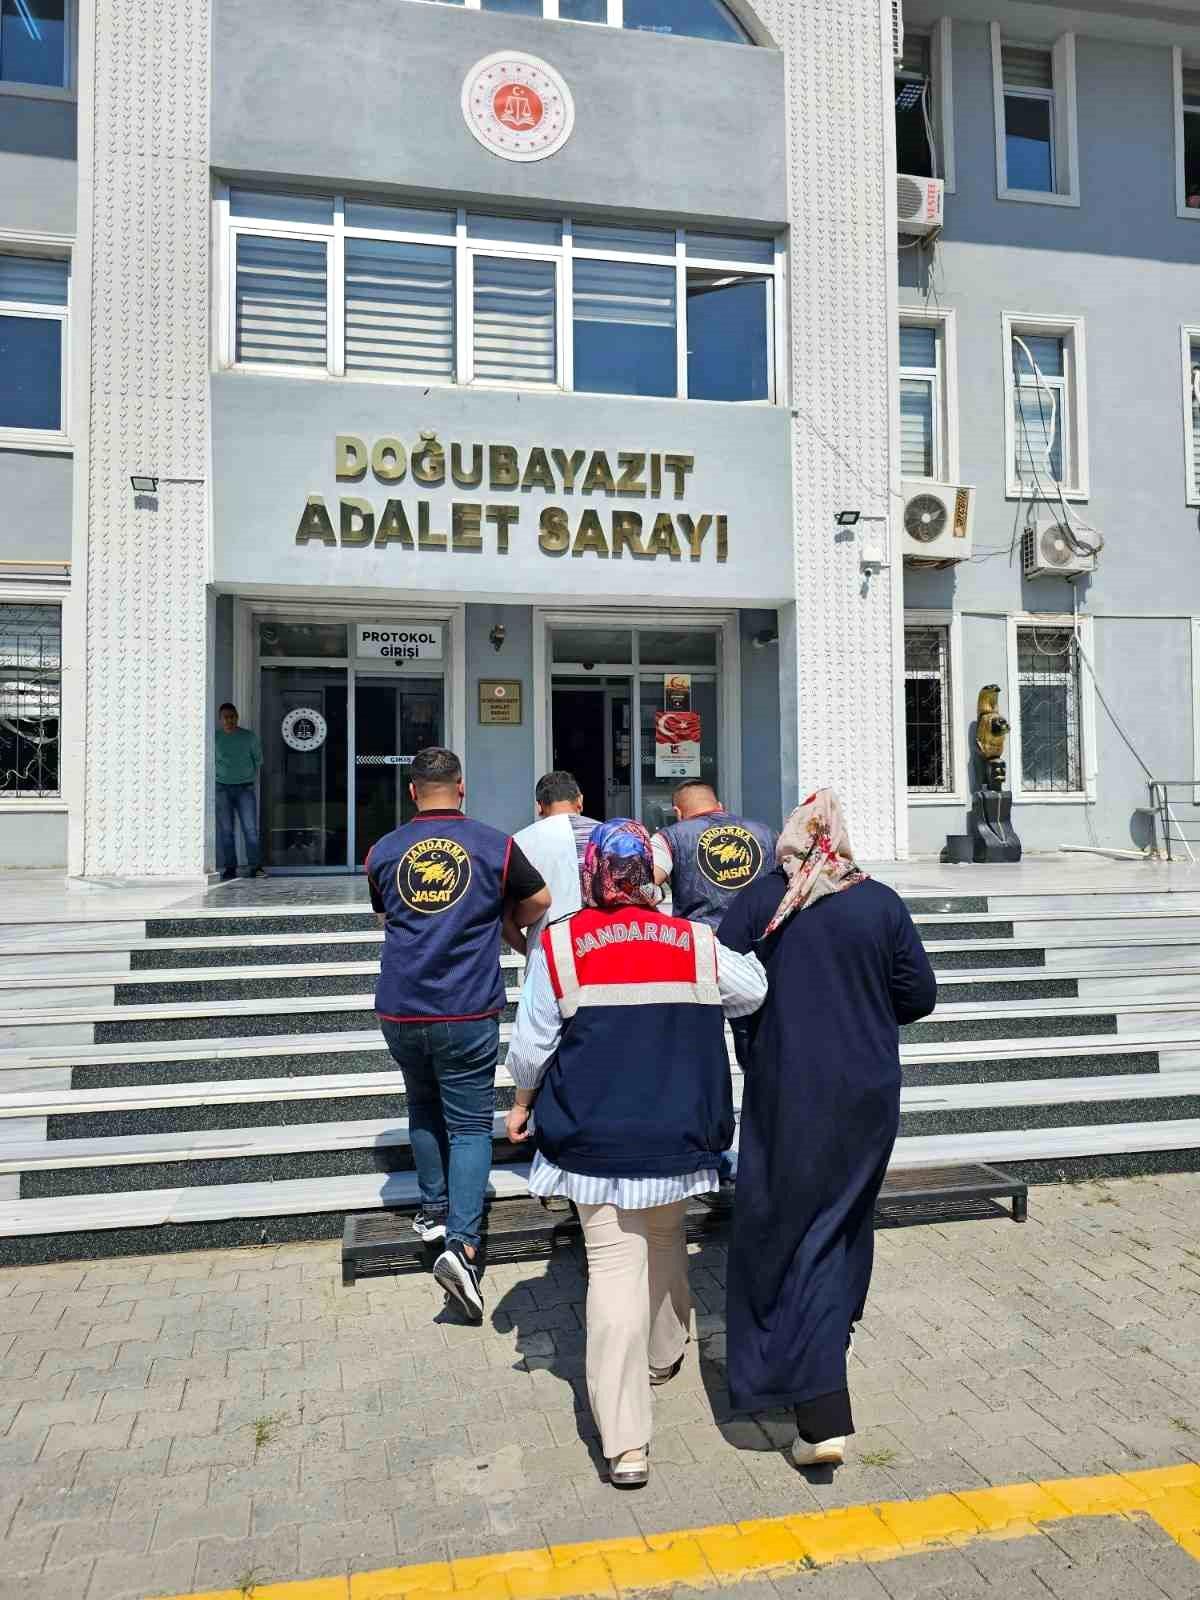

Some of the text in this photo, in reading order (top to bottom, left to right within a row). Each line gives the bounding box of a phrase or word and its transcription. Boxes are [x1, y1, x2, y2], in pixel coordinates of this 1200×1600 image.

[335, 430, 694, 499] DOĞUBAYAZIT
[295, 495, 728, 562] ADALET SARAYI
[362, 631, 436, 644] PROTOKOL
[380, 644, 419, 659] GİRİŞİ
[698, 827, 752, 849] JANDARMA
[407, 839, 468, 864] JANDARMA
[717, 864, 751, 881] JASAT
[411, 889, 452, 903] JASAT
[575, 920, 690, 958] JANDARMA
